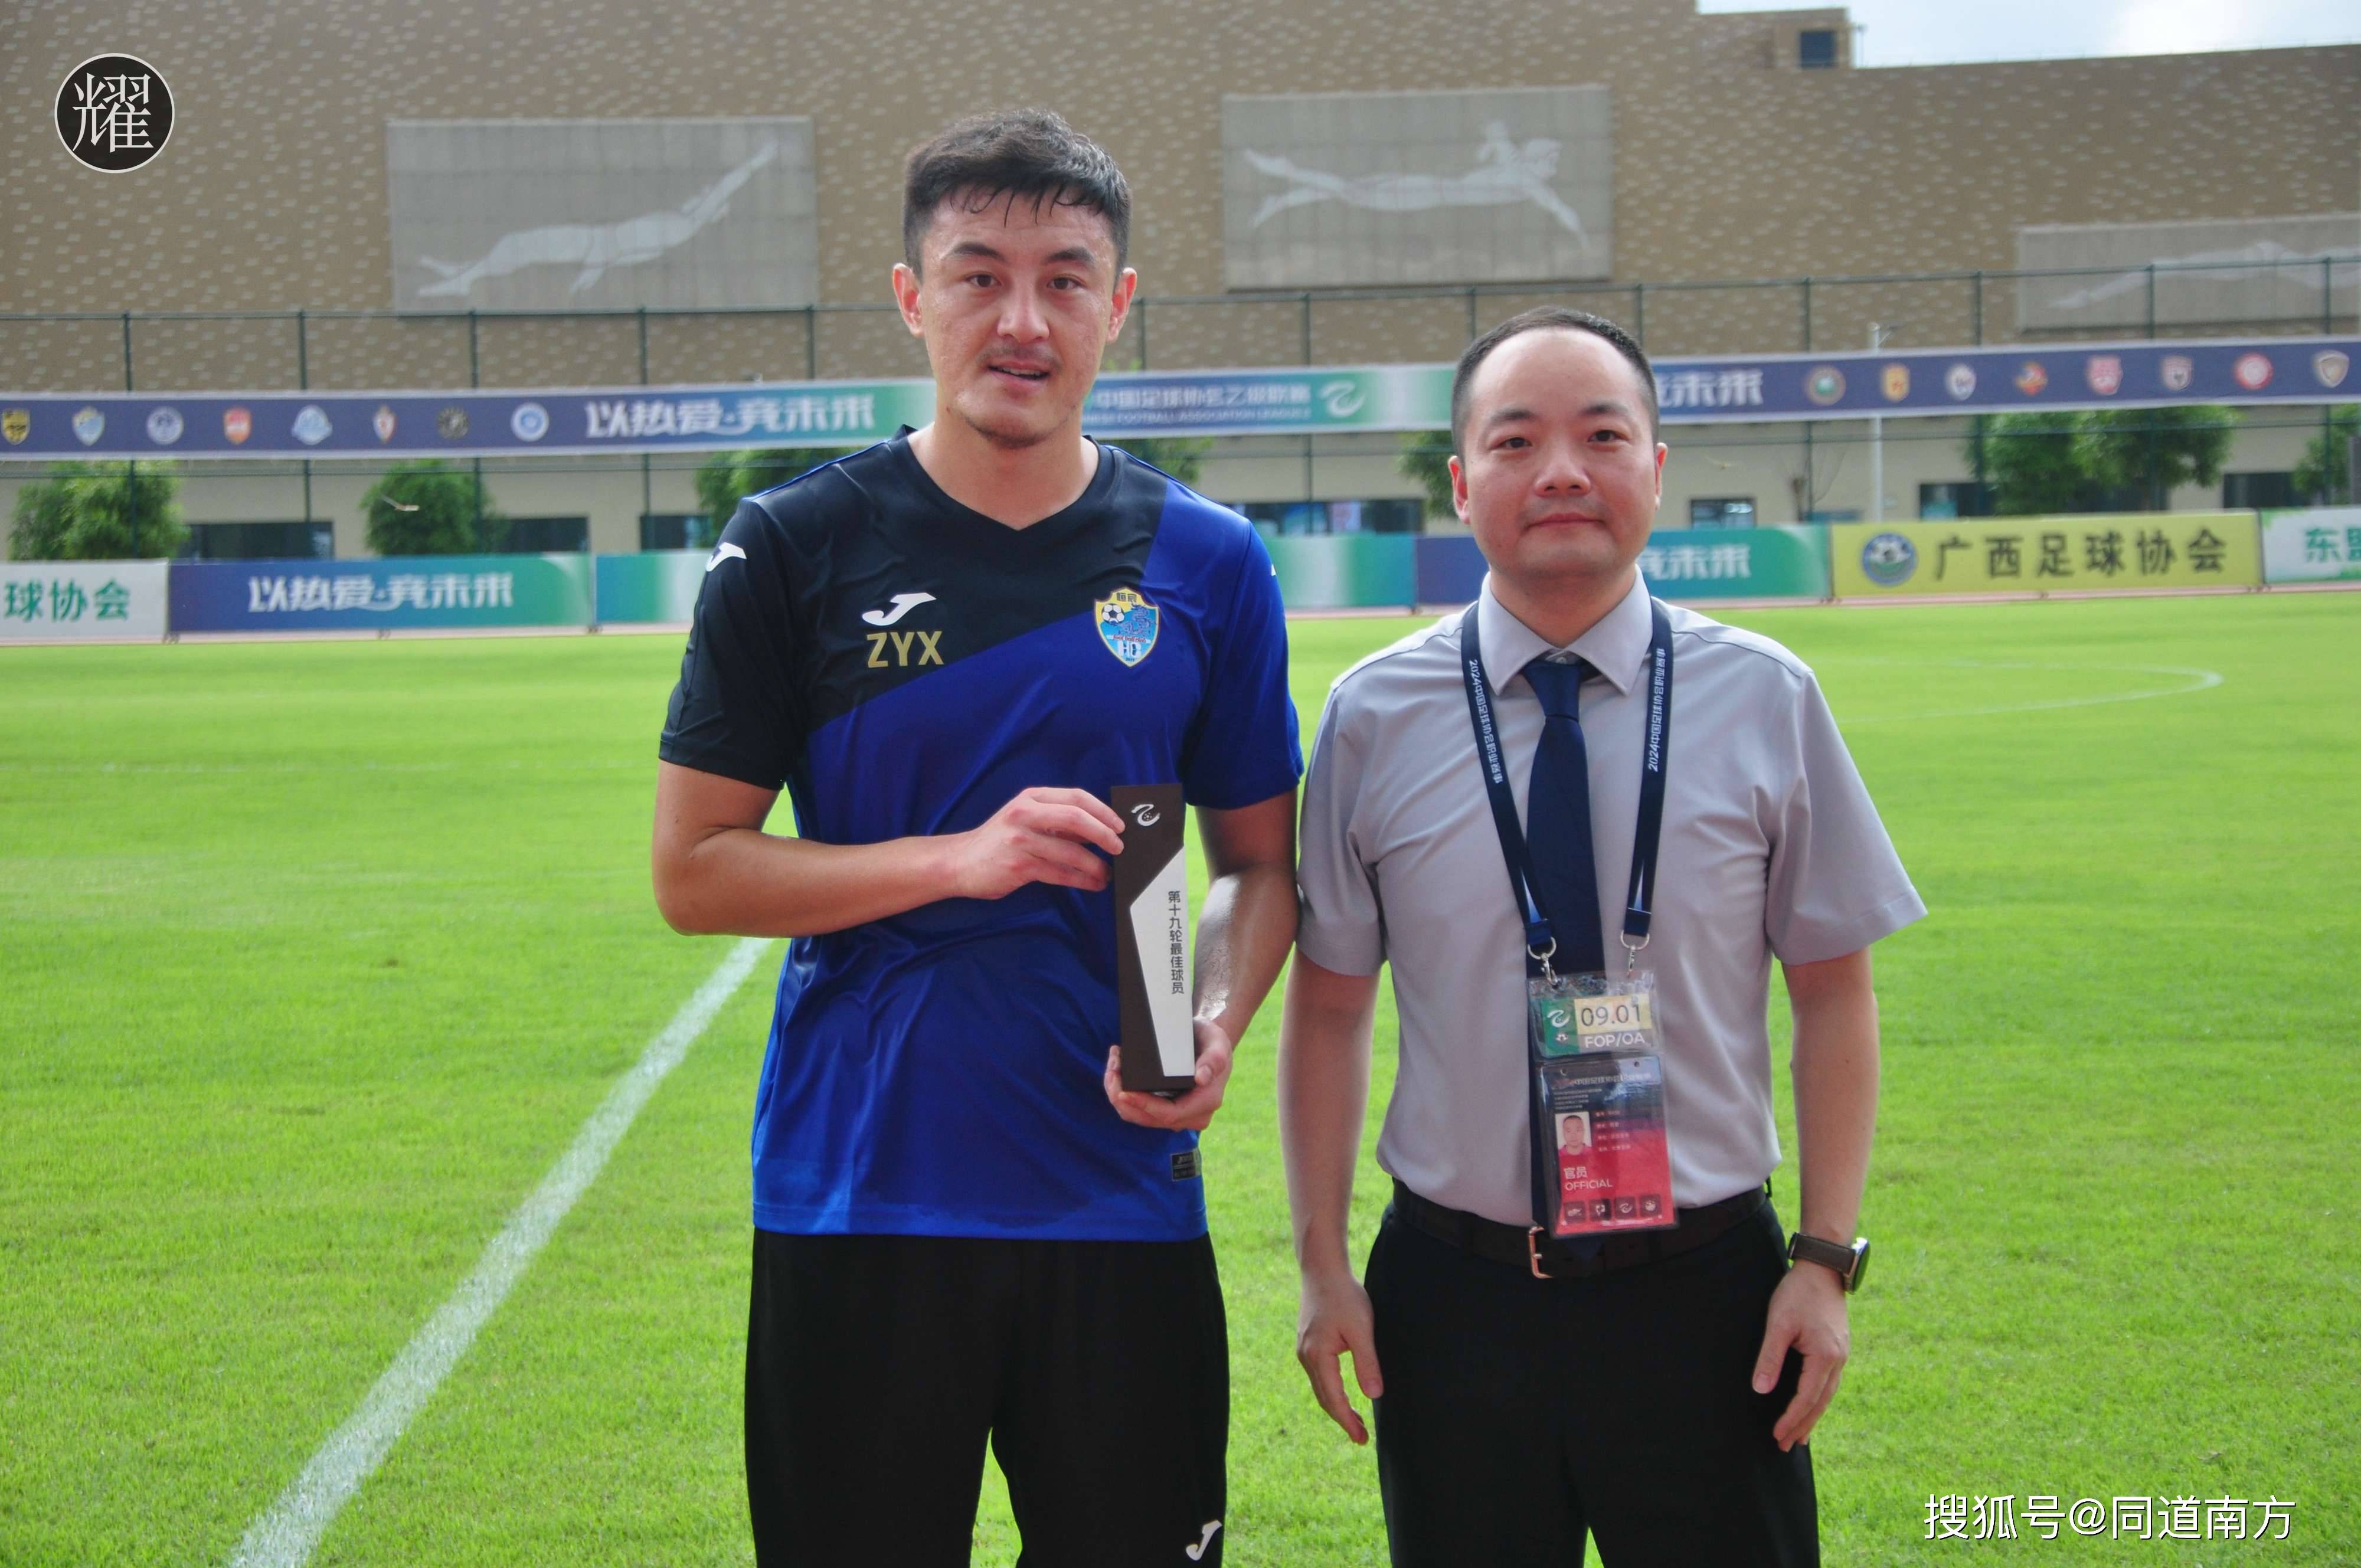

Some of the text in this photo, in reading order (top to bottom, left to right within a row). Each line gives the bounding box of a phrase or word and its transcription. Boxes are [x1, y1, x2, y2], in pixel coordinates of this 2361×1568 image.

[1934, 528, 2228, 581] 广西足球协会
[4, 578, 129, 622] 球协会
[866, 630, 945, 668] ZYX
[1168, 890, 1185, 995] 第十九轮最佳球员
[1581, 1004, 1641, 1027] 09.01
[1584, 1032, 1646, 1049] FOP/OA
[1564, 1166, 1588, 1179] 官员
[1565, 1179, 1613, 1191] OFFICIAL
